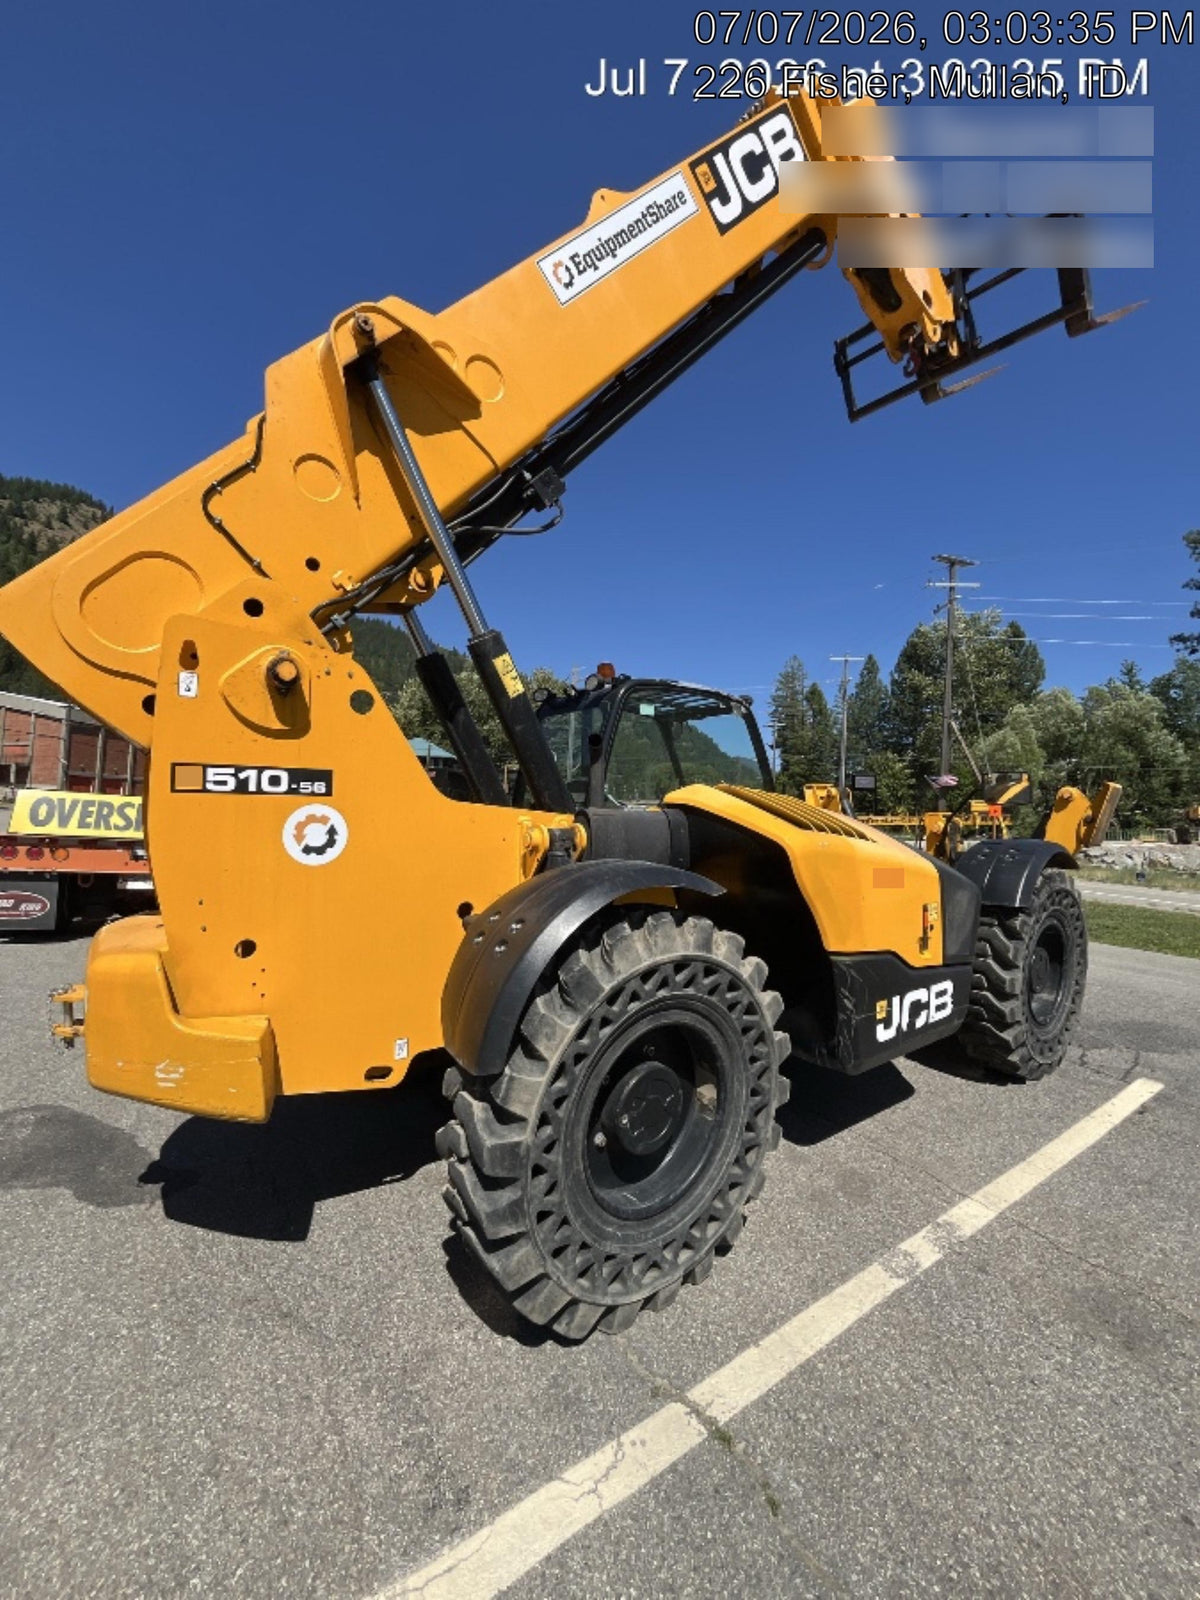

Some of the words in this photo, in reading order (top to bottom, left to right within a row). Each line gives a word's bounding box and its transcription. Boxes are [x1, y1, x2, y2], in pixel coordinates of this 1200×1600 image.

[710, 113, 805, 225] JCB
[571, 190, 687, 276] EquipmentShare
[876, 979, 953, 1042] JCB
